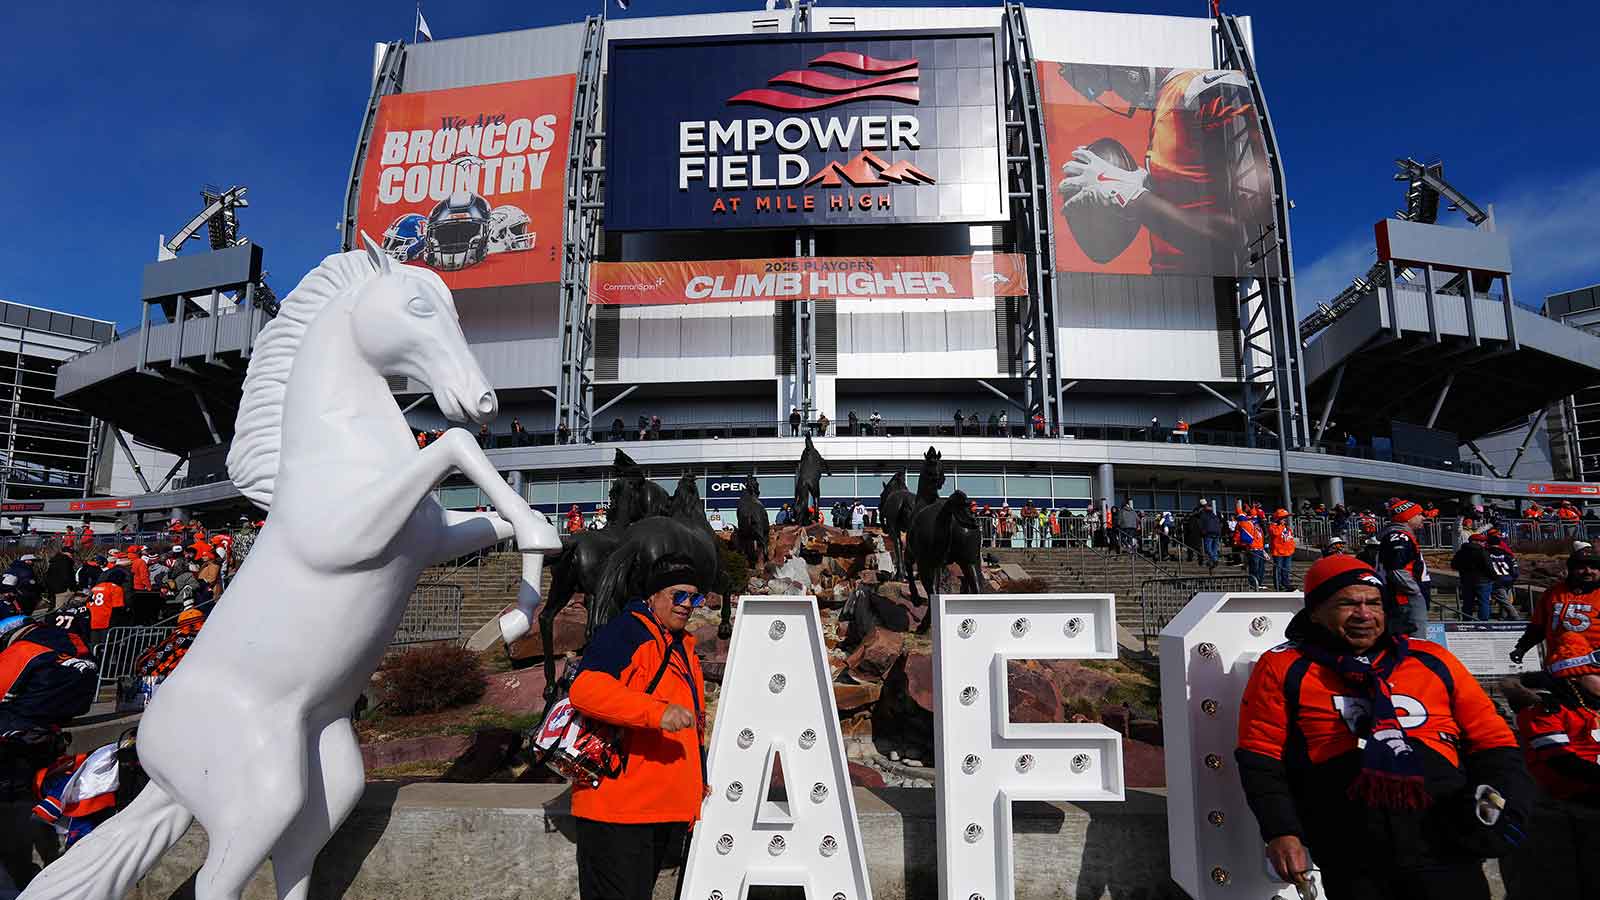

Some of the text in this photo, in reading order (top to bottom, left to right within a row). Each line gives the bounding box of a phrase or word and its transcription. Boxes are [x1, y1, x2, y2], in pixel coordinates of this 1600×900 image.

[441, 112, 506, 132] We Are
[679, 115, 921, 153] EMPOWER
[381, 114, 557, 167] BRONCOS
[378, 151, 550, 204] COUNTRY
[679, 154, 811, 188] FIELD
[712, 193, 892, 213] AT MILE HIGH
[765, 260, 875, 273] 2025 PLAYOFFS
[685, 271, 956, 299] CLIMB HIGHER
[711, 482, 747, 492] OPEN
[55, 615, 75, 630] 27
[1552, 602, 1592, 632] 15
